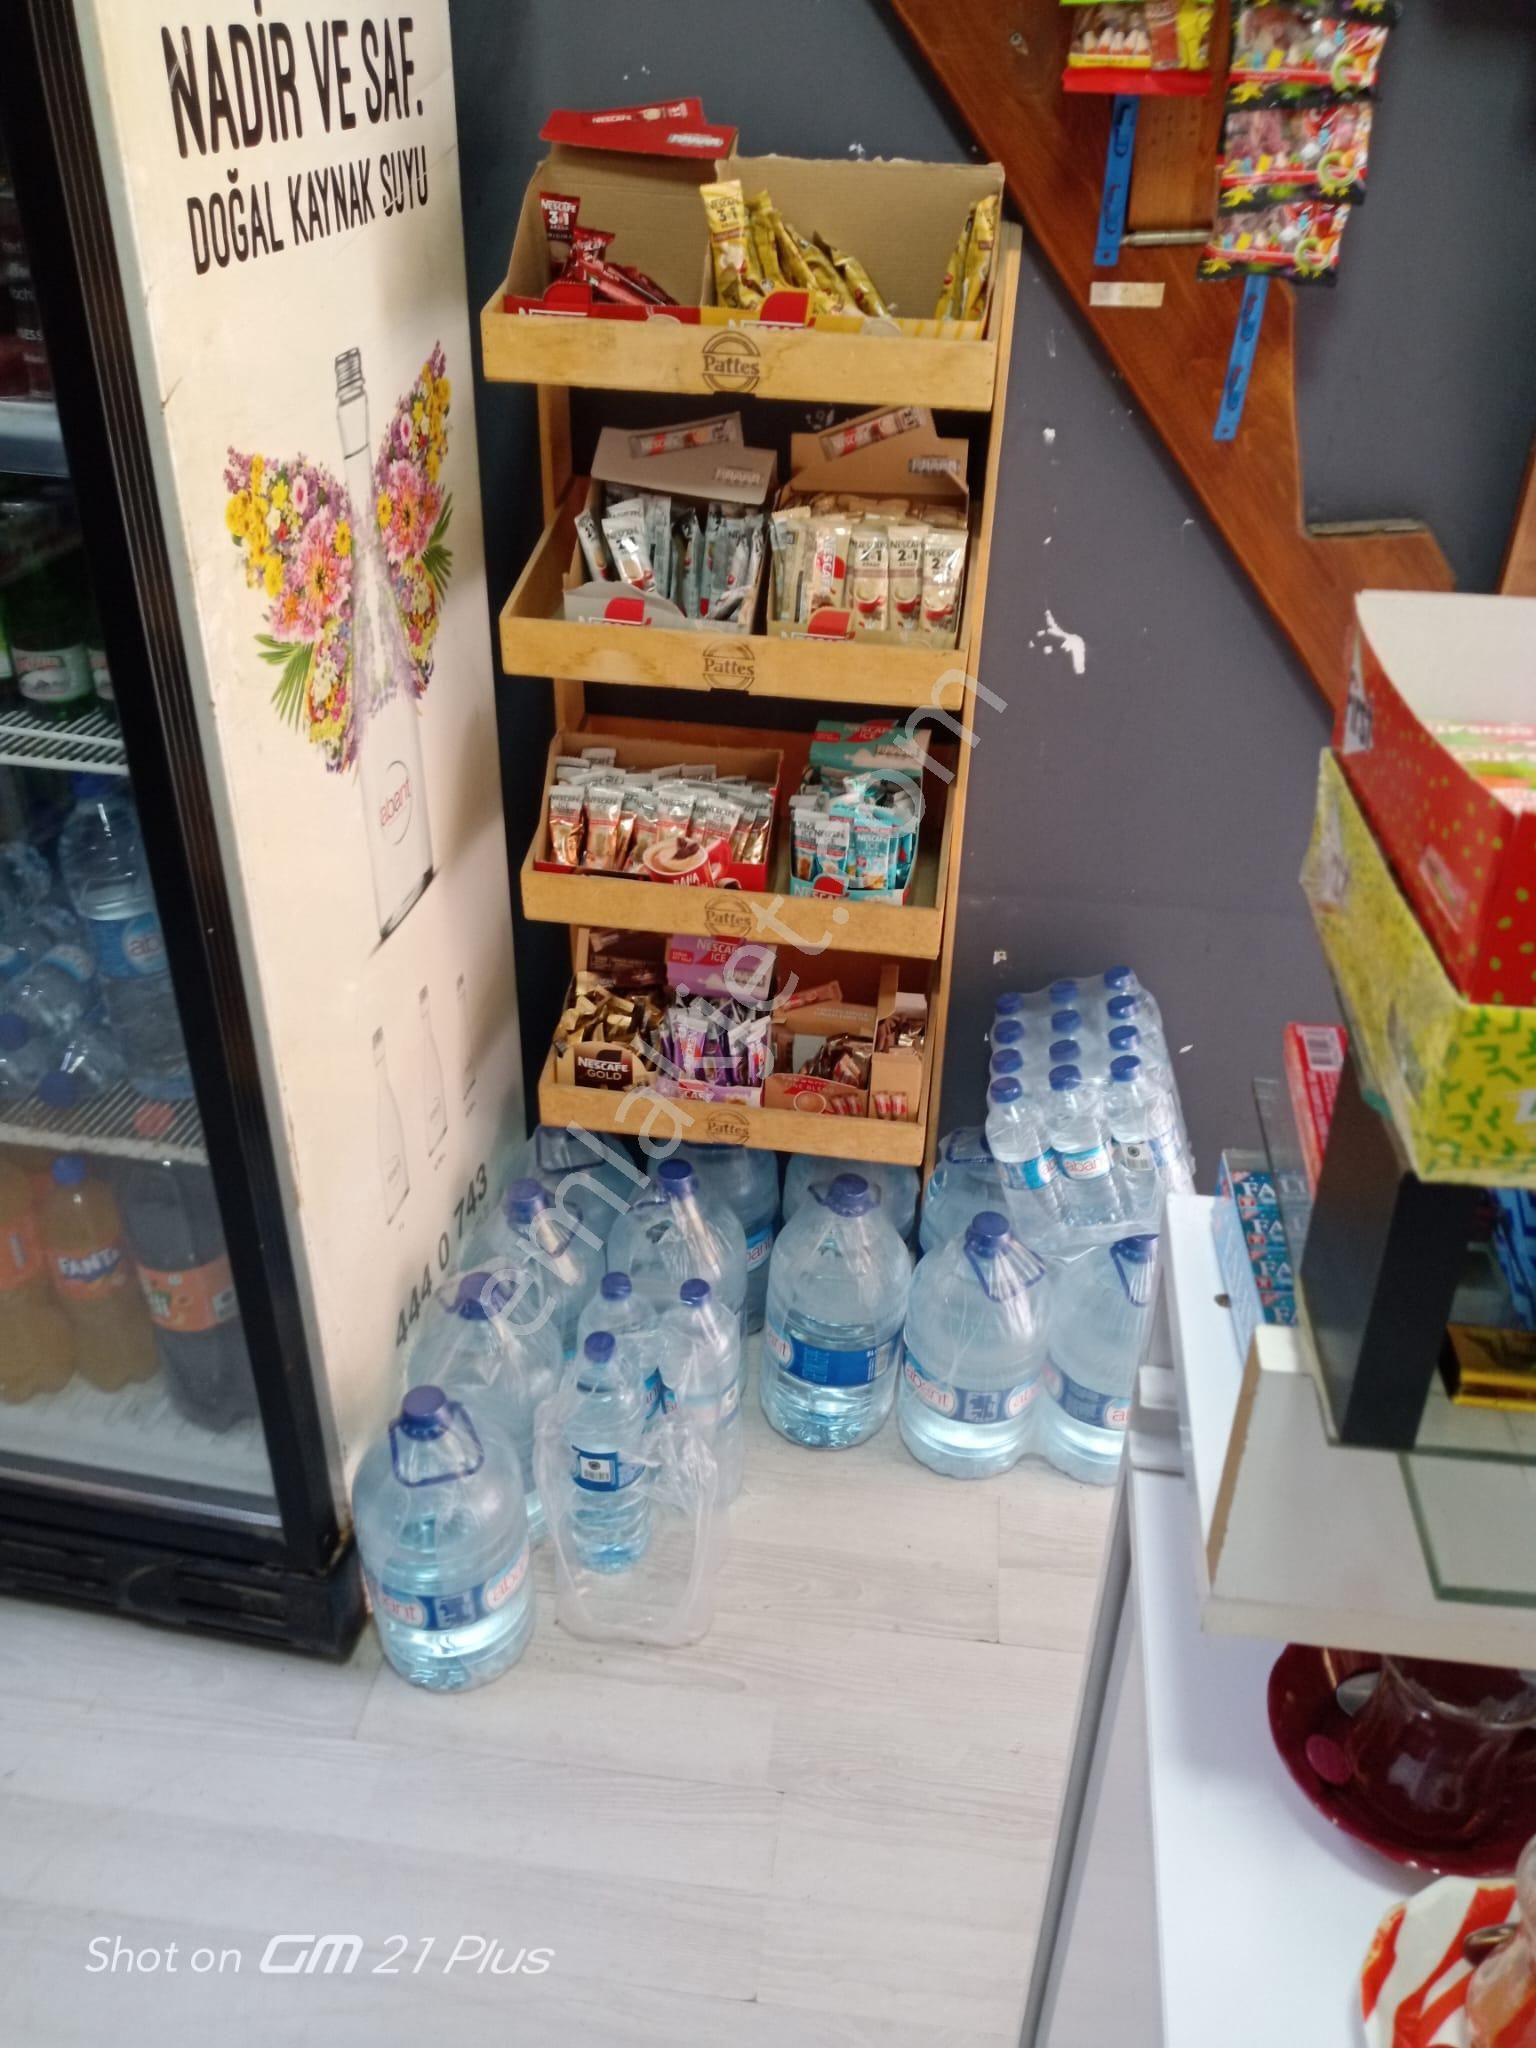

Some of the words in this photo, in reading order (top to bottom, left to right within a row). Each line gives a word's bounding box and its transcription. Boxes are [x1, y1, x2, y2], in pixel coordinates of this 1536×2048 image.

[161, 0, 303, 158] NADİR
[305, 20, 356, 133] VE
[361, 17, 424, 124] SAF.
[187, 168, 284, 275] DOĞAL
[288, 158, 375, 246] KAYNAK
[380, 145, 429, 217] SUYU
[703, 355, 761, 376] Pattes
[703, 657, 755, 678] Pattes
[704, 909, 752, 927] Pattes
[710, 951, 727, 963] ICE
[577, 1056, 630, 1073] NESCAFE
[586, 1069, 623, 1081] GOLD
[705, 1121, 750, 1138] Pattes
[395, 1263, 434, 1348] 444
[438, 1231, 451, 1272] 0
[453, 1162, 488, 1240] 743
